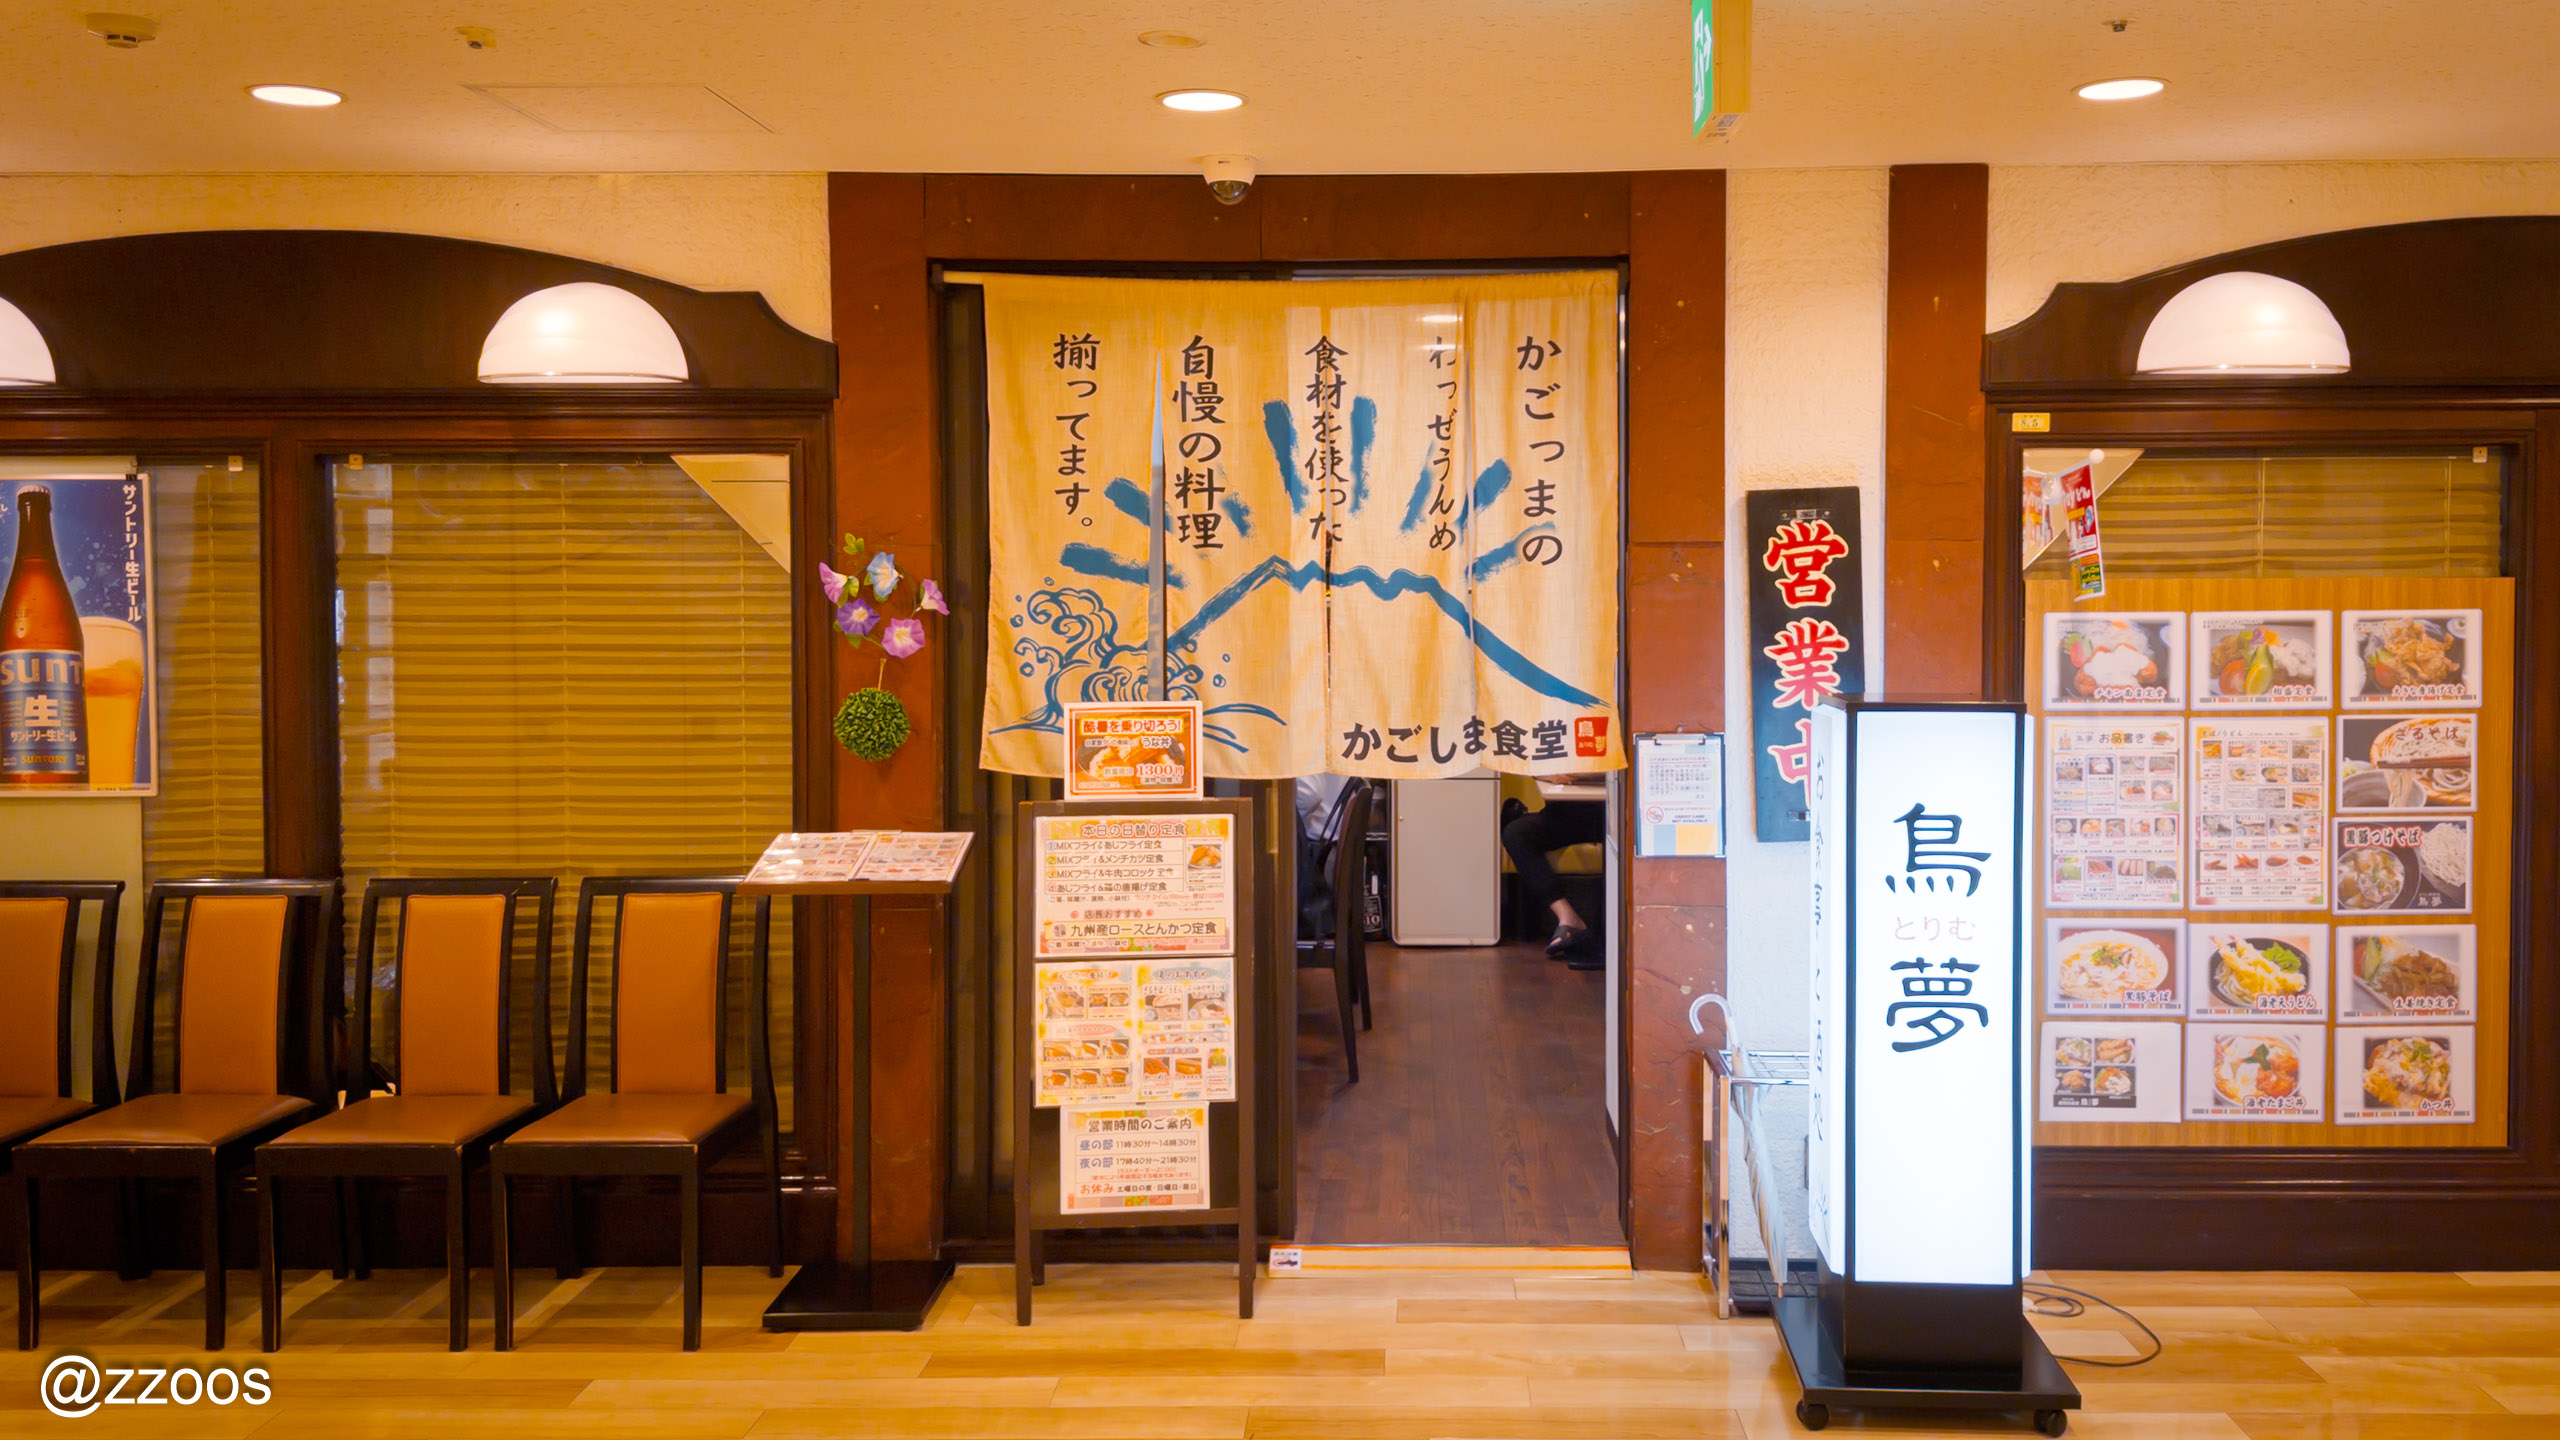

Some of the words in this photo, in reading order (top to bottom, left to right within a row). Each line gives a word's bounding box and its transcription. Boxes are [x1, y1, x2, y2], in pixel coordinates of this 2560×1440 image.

[1052, 332, 1101, 528] 揃ってます。
[1171, 334, 1227, 550] 自慢の料理
[1303, 334, 1350, 543] 食材を使った
[122, 484, 142, 623] サントリー生ビール
[23, 694, 62, 728] 生
[10, 729, 78, 743] サントリー生ビール
[1340, 714, 1569, 765] かごしま食堂
[2098, 733, 2146, 744] お品書き
[2394, 726, 2461, 741] ざるそば
[1082, 823, 1187, 837] 本日の日替り定食
[2345, 828, 2421, 846] 黒豚つけそば
[1886, 802, 1992, 897] 鳥
[1083, 909, 1143, 919] 店長おすすめ
[1070, 921, 1217, 937] 九州産ロースとんかつ定食
[1894, 915, 1978, 941] とりむ
[2124, 990, 2170, 1002] 黒豚そば
[2258, 996, 2314, 1009] 海老天うどん
[2394, 997, 2457, 1009] 生姜焼き定食
[2421, 1099, 2453, 1110] かつ丼
[1088, 1117, 1192, 1133] 営業時間のご案内
[1079, 1139, 1114, 1151] 昼の部
[1079, 1156, 1114, 1169] 夜の部
[1079, 1184, 1114, 1195] お休み
